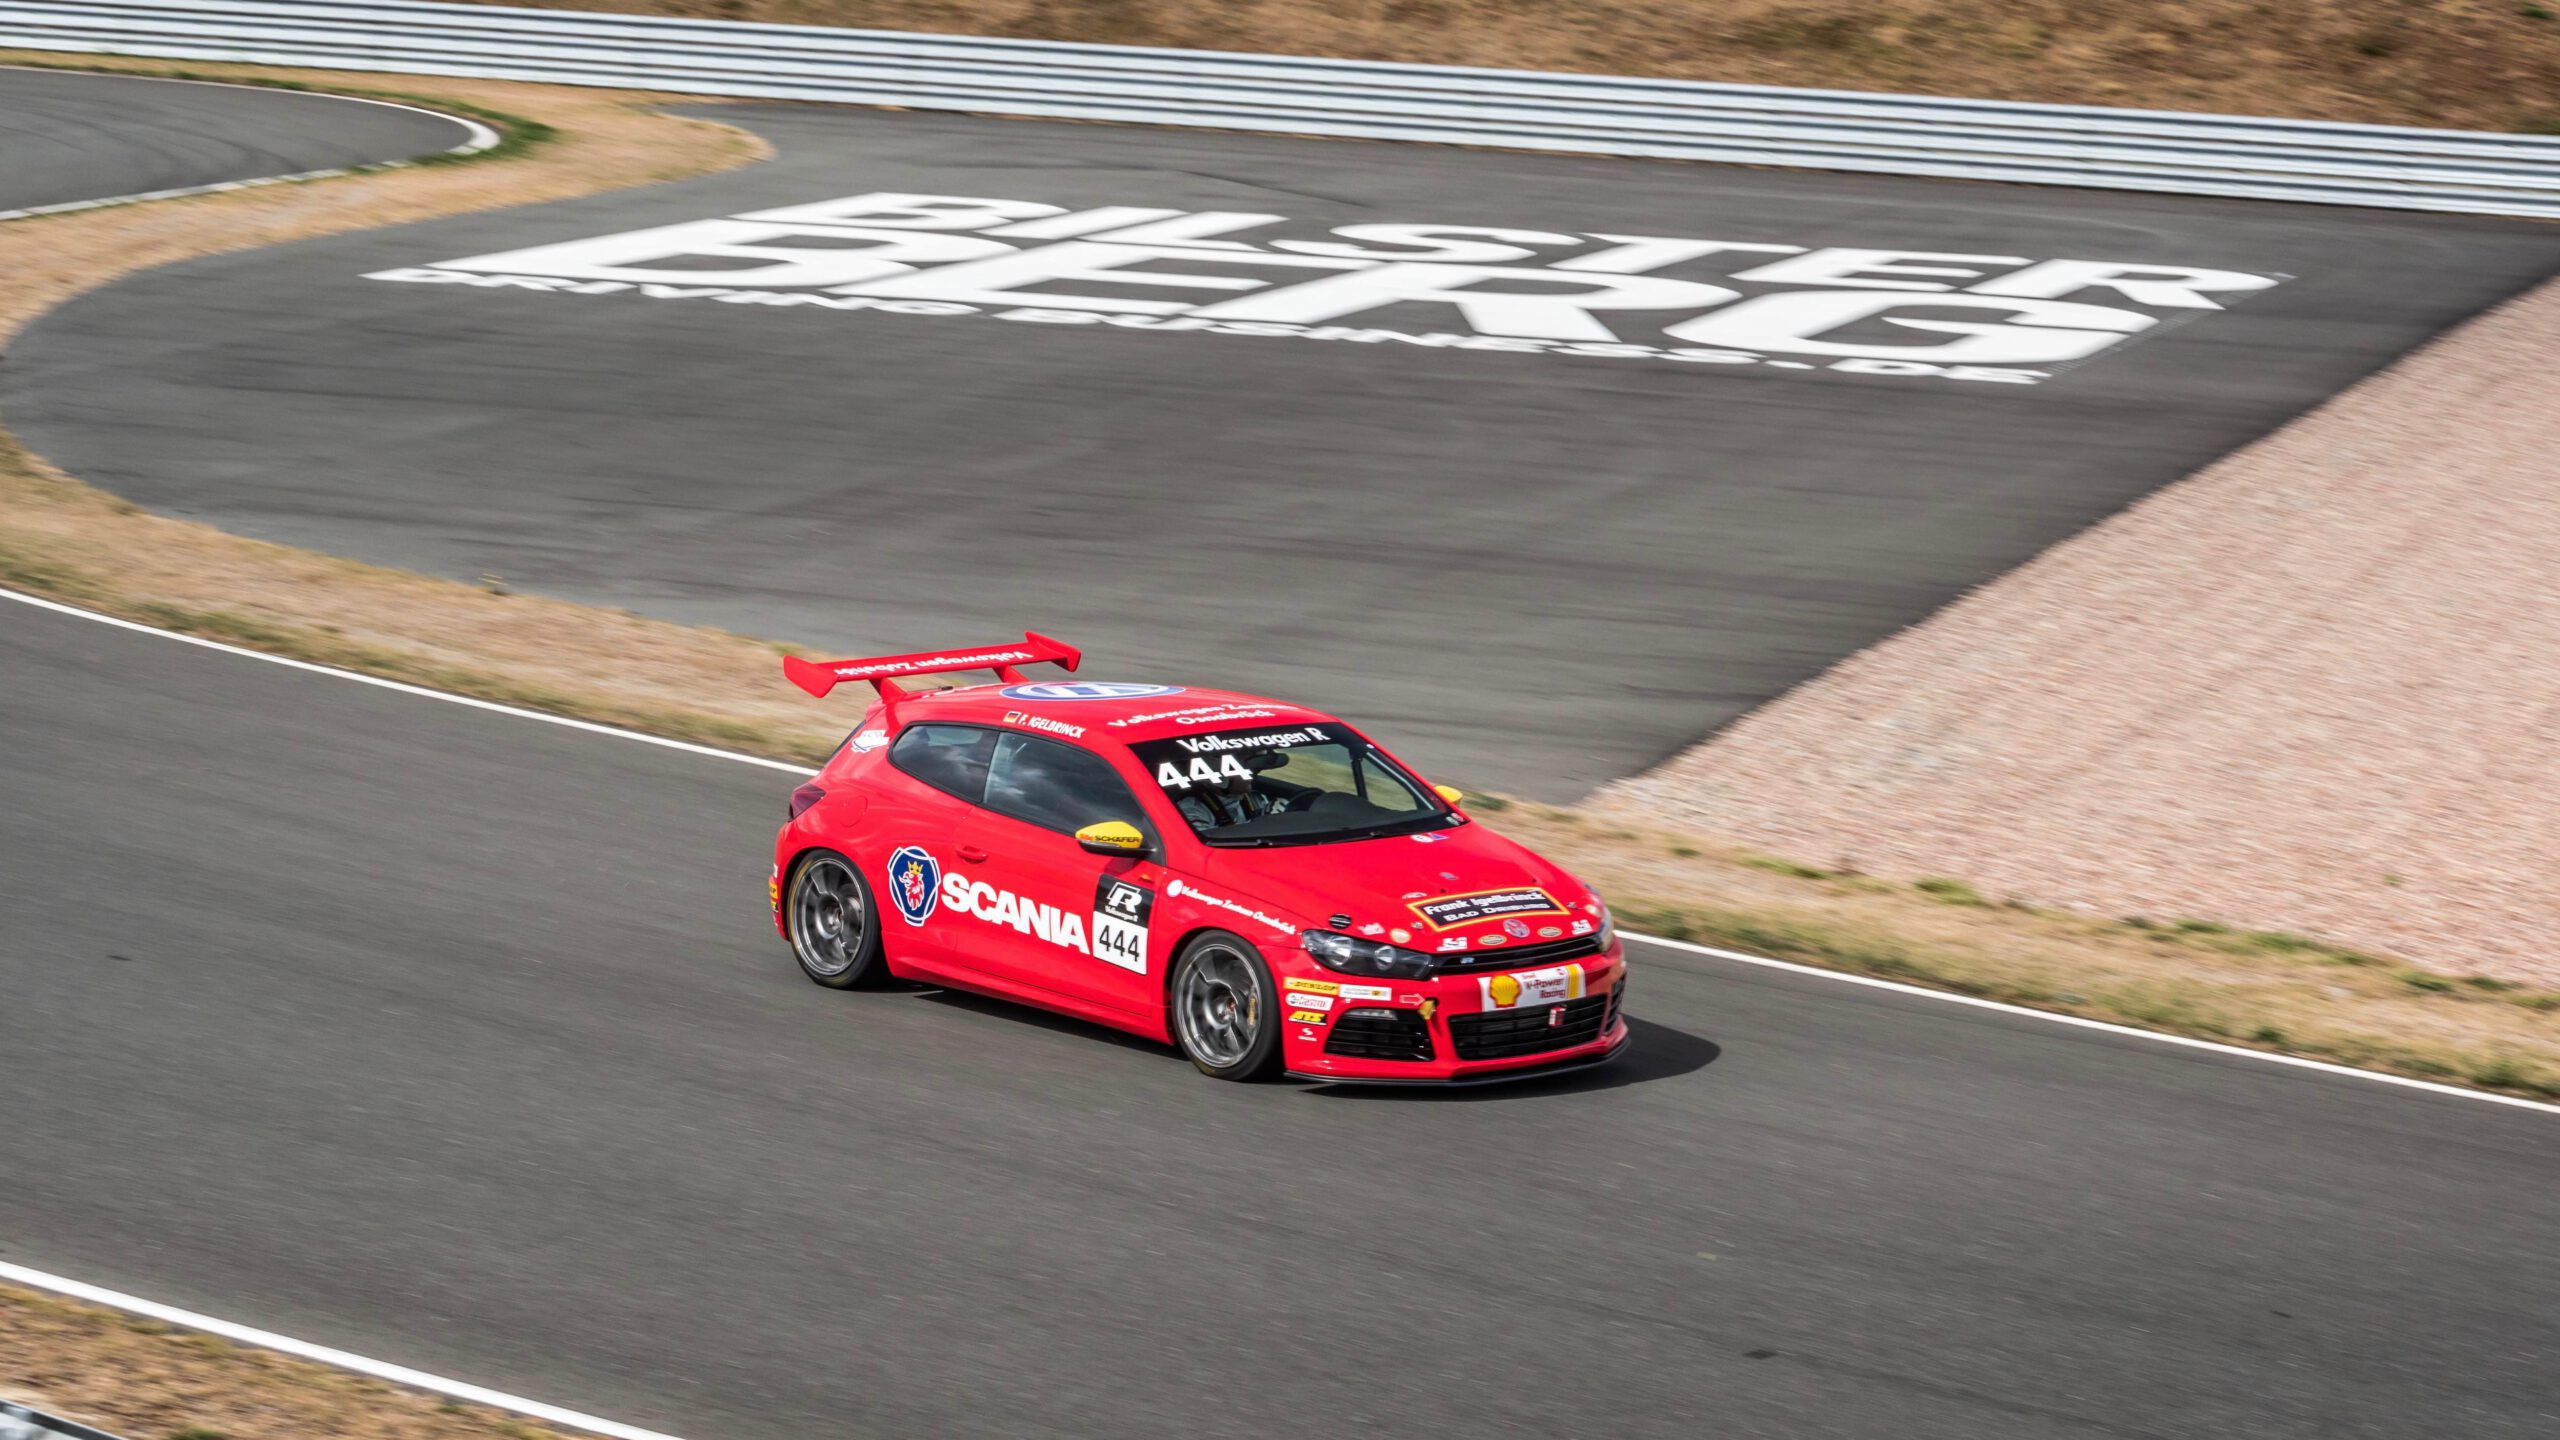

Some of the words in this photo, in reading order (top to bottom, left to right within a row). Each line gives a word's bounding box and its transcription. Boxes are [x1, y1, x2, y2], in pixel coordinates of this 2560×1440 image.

[729, 191, 2281, 310] BILSTER
[357, 268, 983, 316] DRIVING
[424, 217, 2161, 363] BERG
[914, 650, 1034, 668] Volkswagen
[1018, 713, 1029, 727] F.
[1027, 715, 1086, 738] IGELBRINCK
[1107, 703, 1221, 728] Volkswagen
[1175, 710, 1276, 725] Osnabrück
[1176, 730, 1308, 753] Volkswagen
[1306, 727, 1332, 743] R
[1157, 754, 1254, 790] 444
[941, 871, 1091, 955] SCANIA
[1423, 899, 1470, 915] Frank
[1099, 925, 1140, 962] 444
